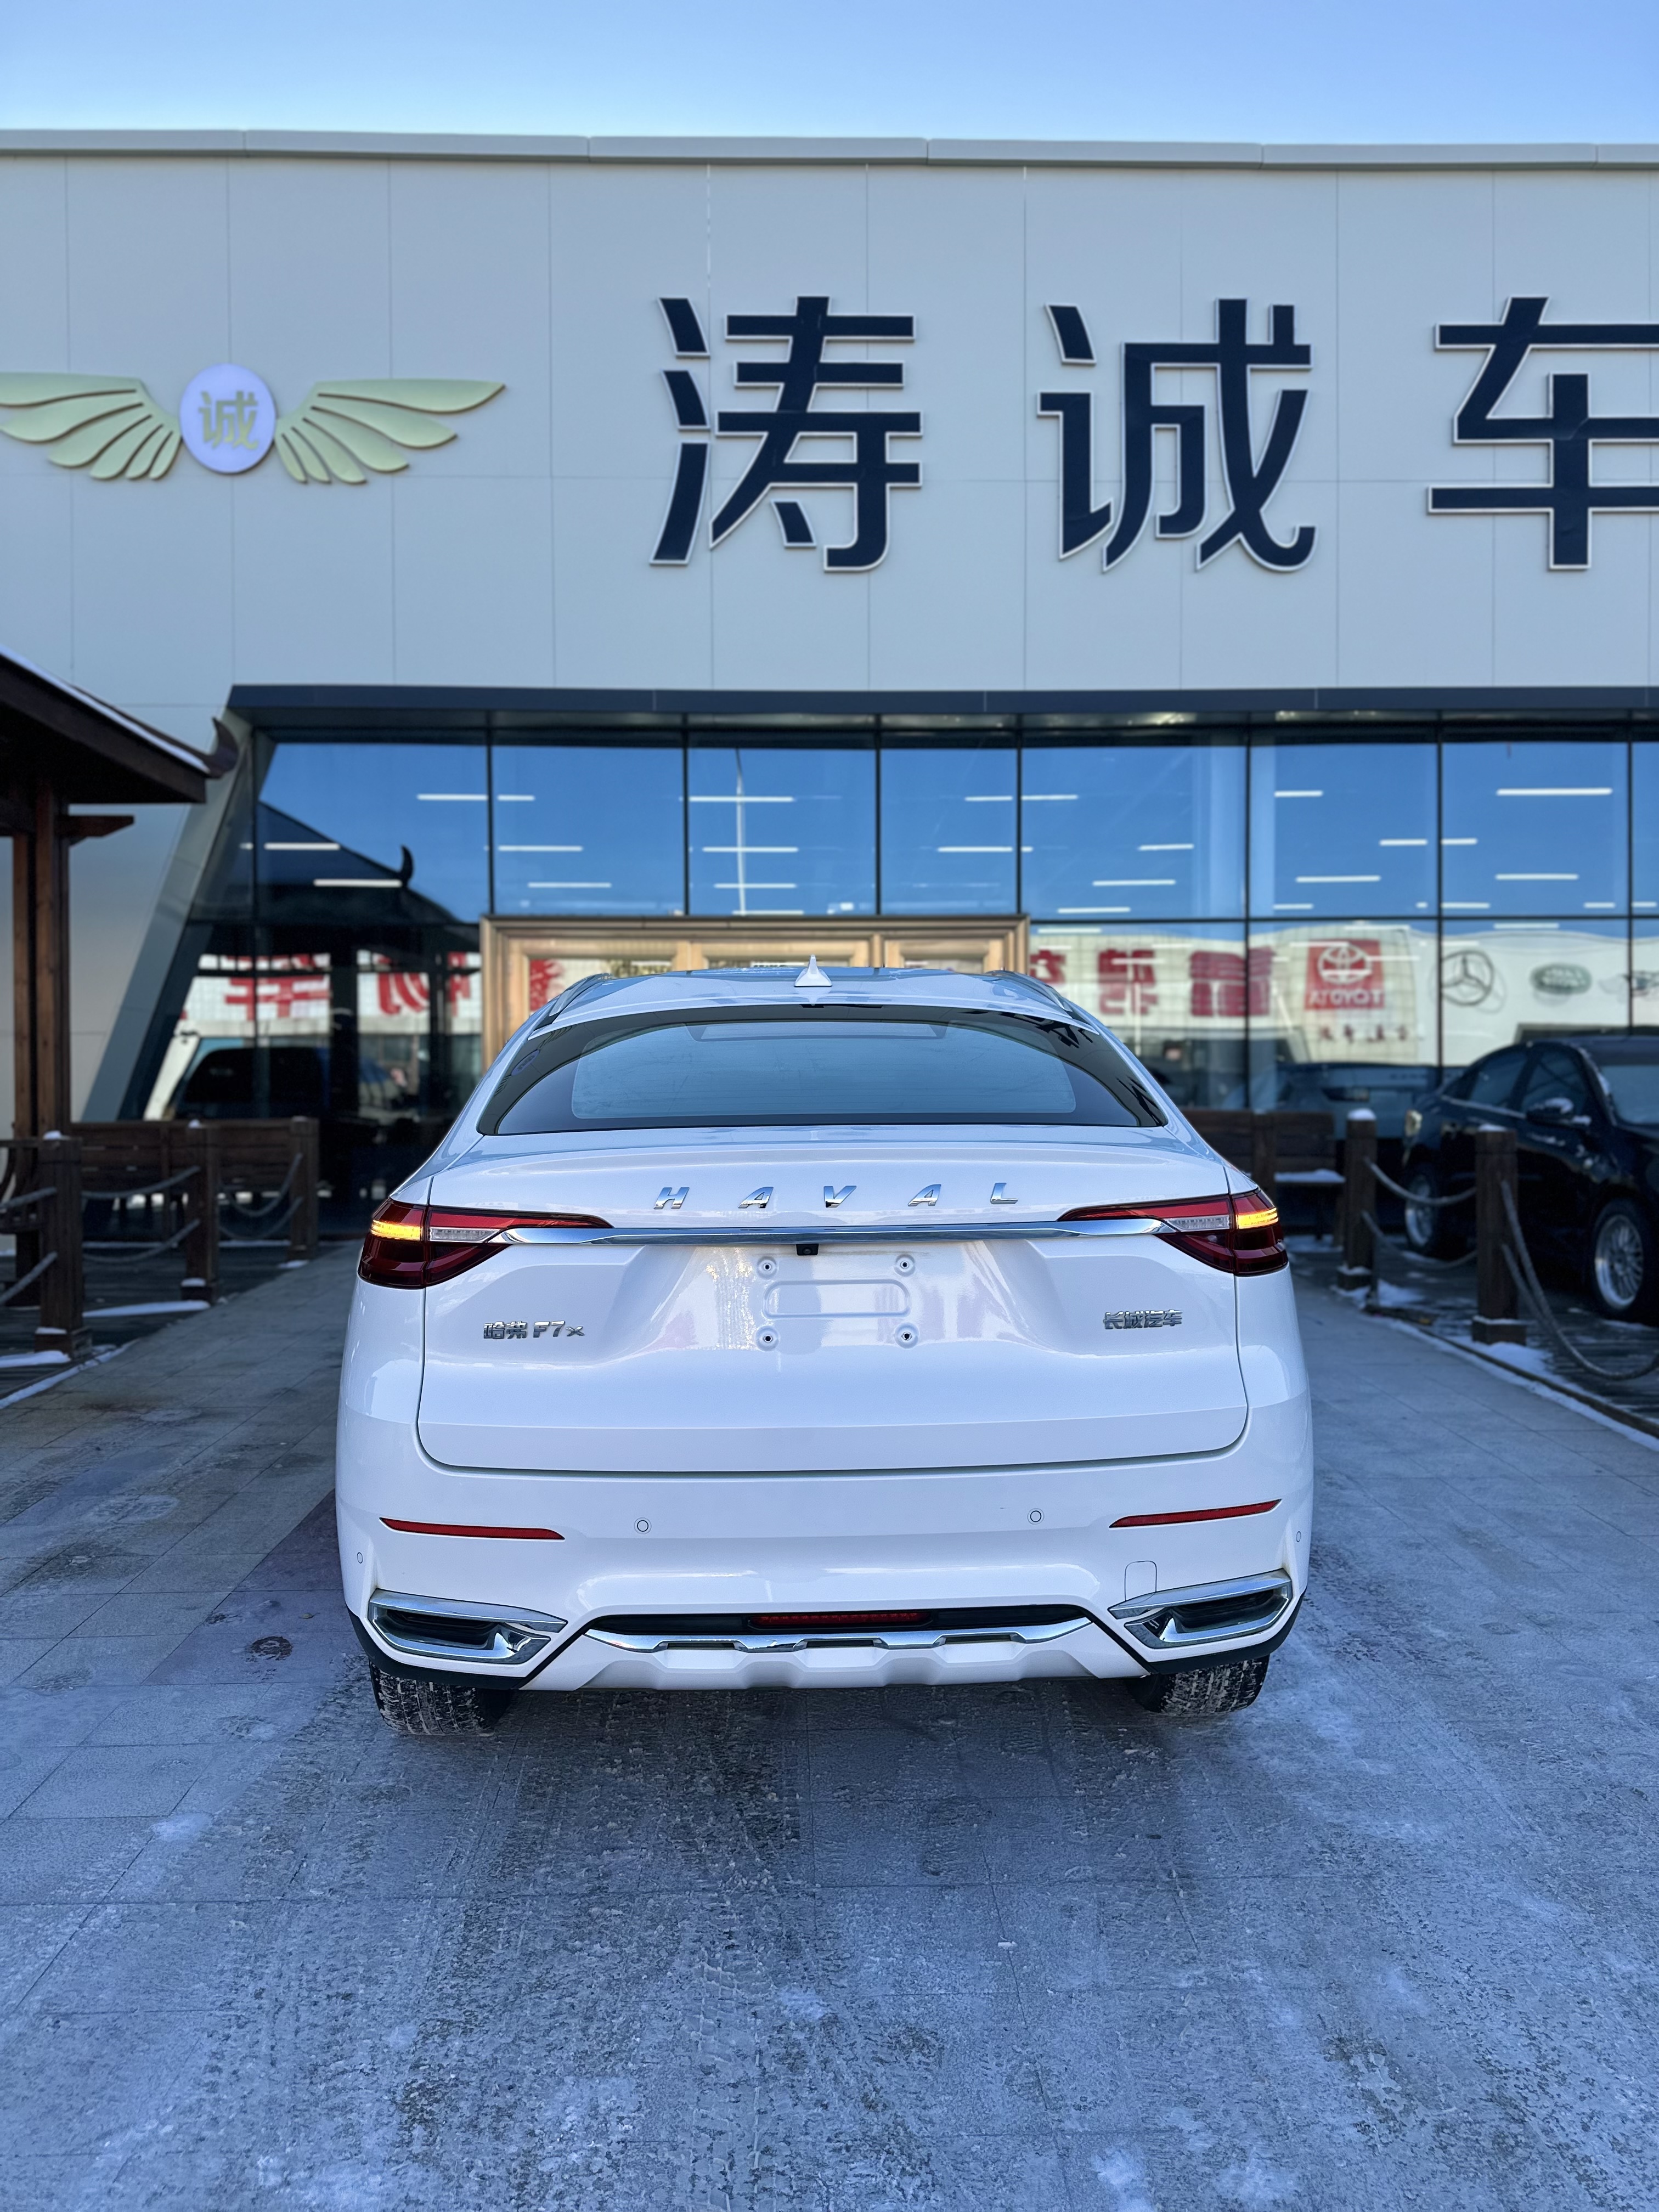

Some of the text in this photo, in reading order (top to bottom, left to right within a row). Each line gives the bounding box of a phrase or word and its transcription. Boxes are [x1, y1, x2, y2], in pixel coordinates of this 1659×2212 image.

[198, 390, 259, 450] 诚
[649, 295, 1659, 573] 涛诚车
[653, 1182, 1019, 1210] HAVAL
[483, 1321, 527, 1340] 哈弗
[1103, 1308, 1183, 1330] 长城汽车
